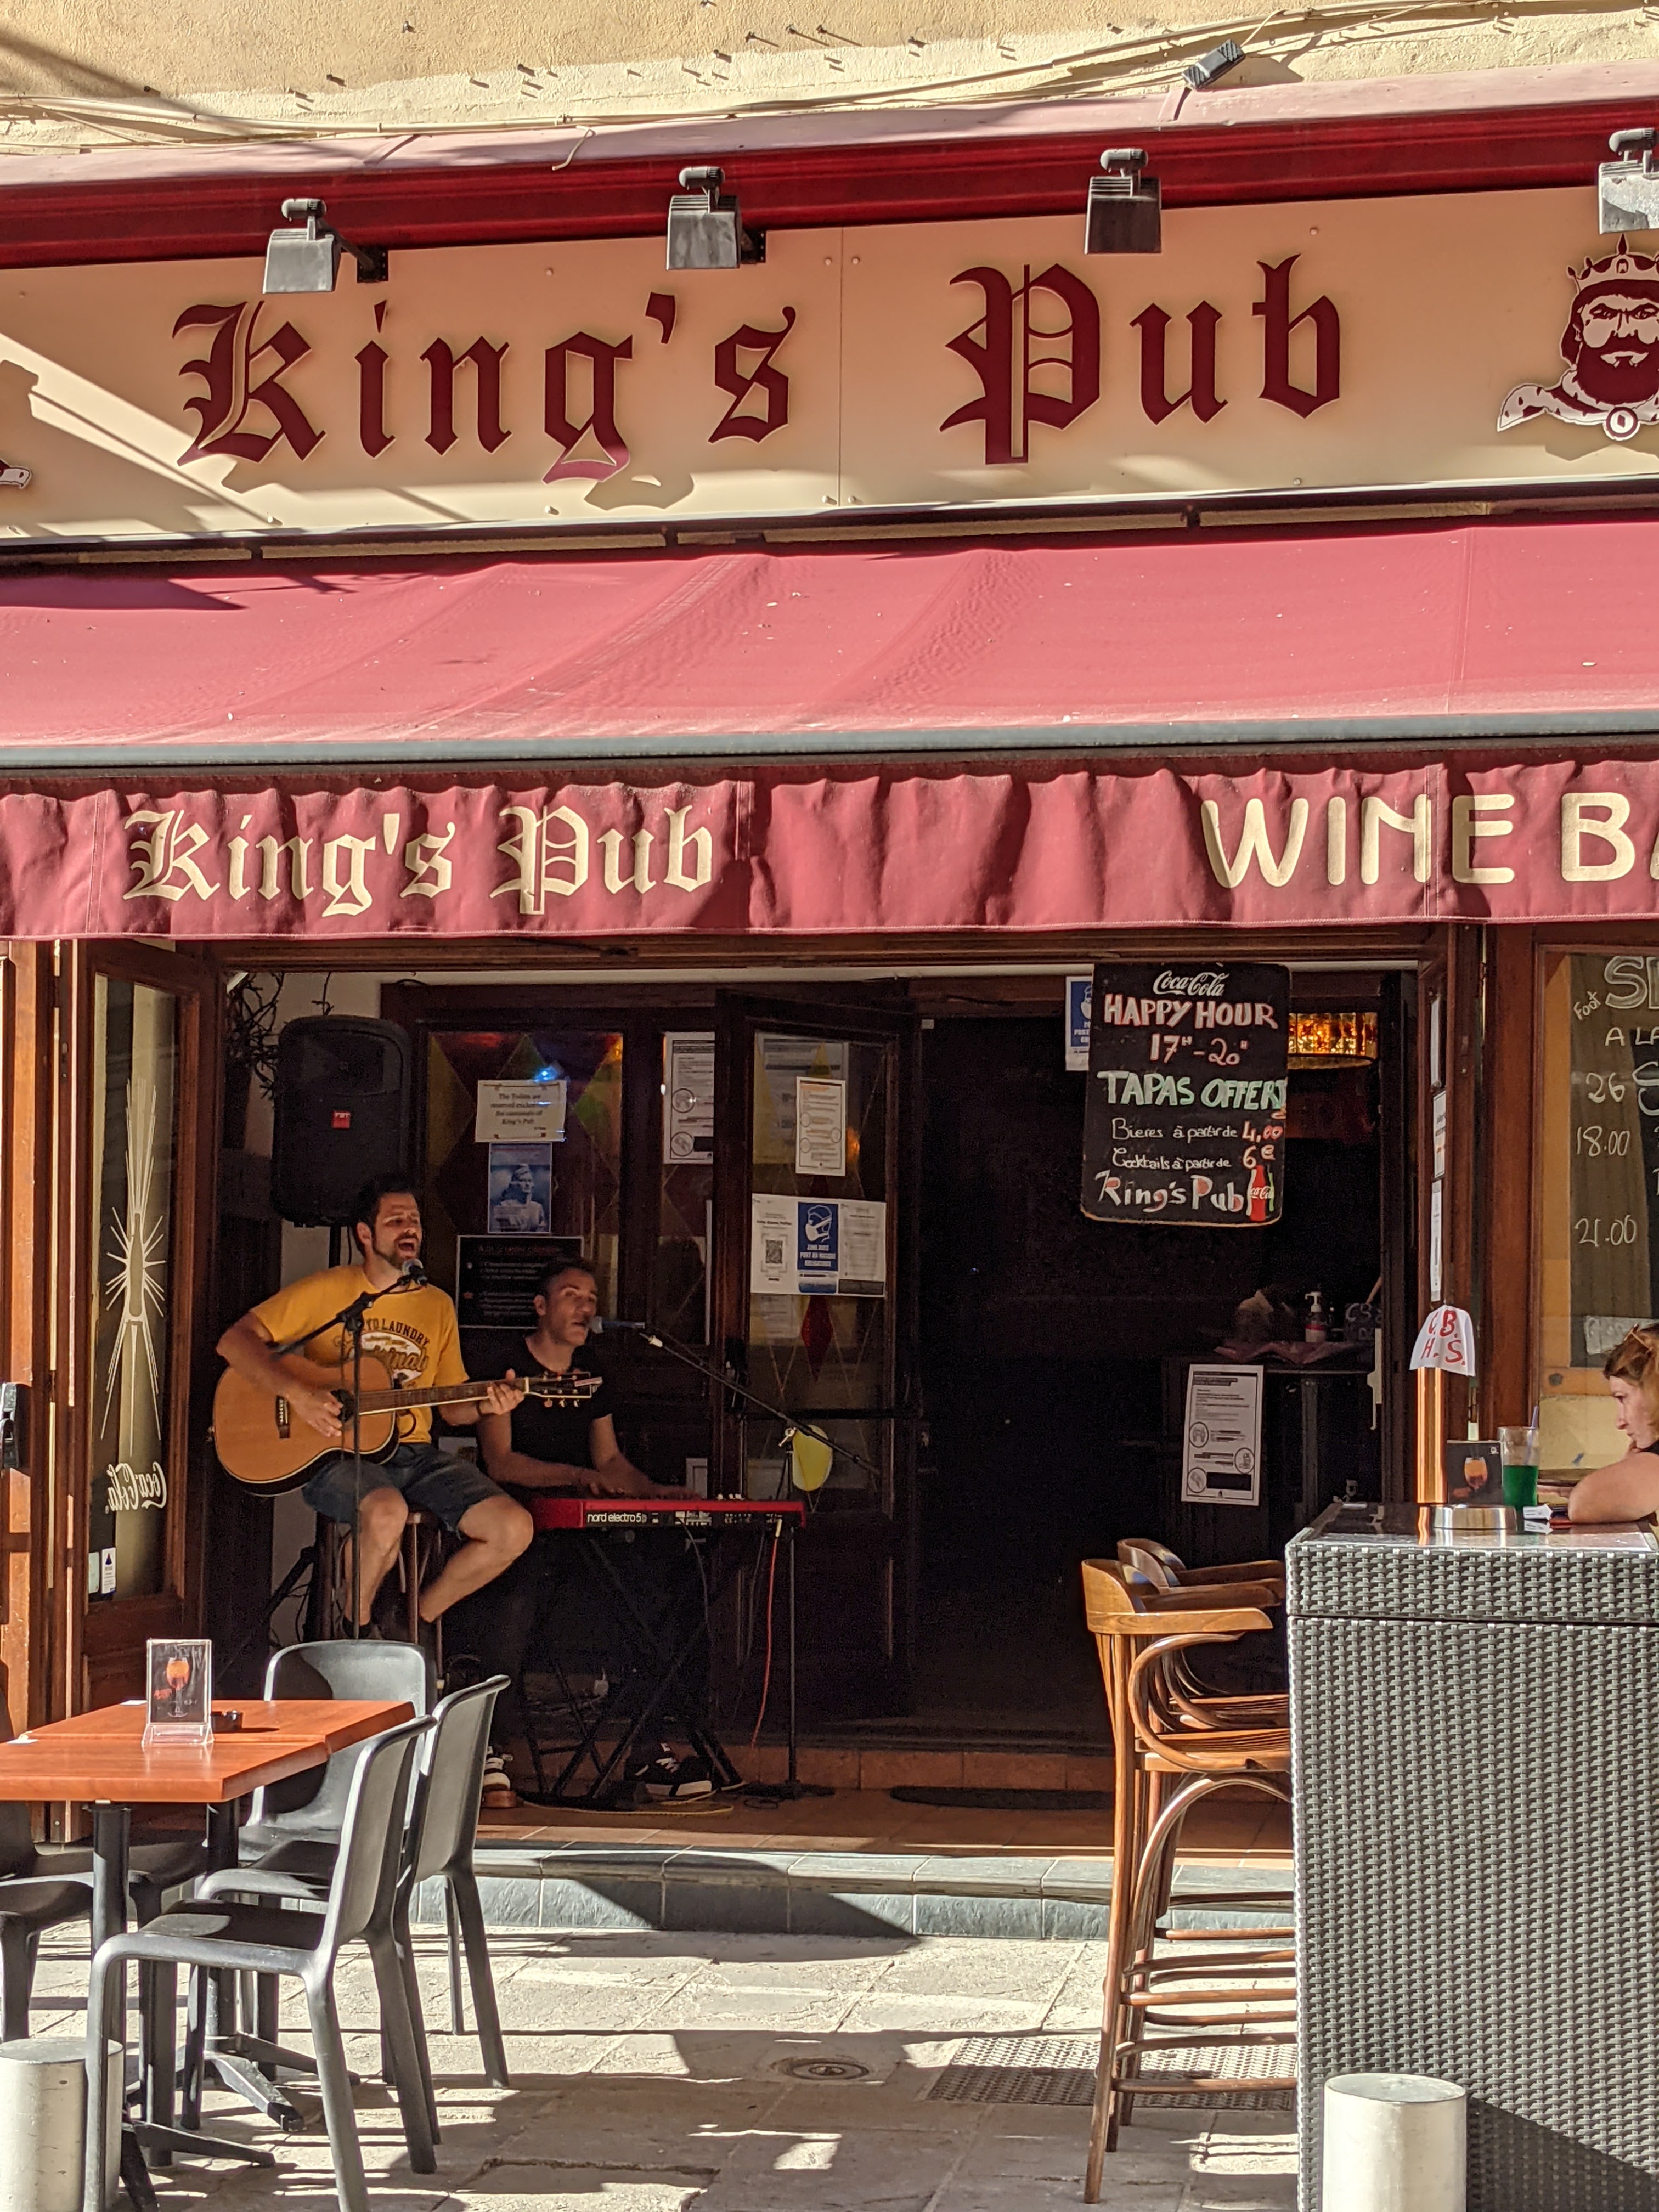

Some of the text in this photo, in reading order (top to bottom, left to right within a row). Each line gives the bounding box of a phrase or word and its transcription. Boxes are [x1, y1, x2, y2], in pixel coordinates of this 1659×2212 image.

[172, 253, 1340, 484] King's Pub
[1200, 792, 1659, 888] WINE B
[123, 804, 713, 918] King's Pub
[1604, 955, 1659, 1009] S
[1104, 993, 1279, 1029] HAPPY HOUR
[1573, 990, 1601, 1020] Foot
[1605, 1026, 1625, 1047] A
[1097, 1070, 1195, 1105] TAPAS
[1585, 1071, 1625, 1103] 26
[1576, 1126, 1630, 1157] 18.00
[1190, 1175, 1244, 1212] Pub
[1574, 1214, 1637, 1248] 21.00
[381, 1318, 430, 1346] LAUNDRY
[587, 1512, 607, 1523] nord
[608, 1512, 636, 1522] electro
